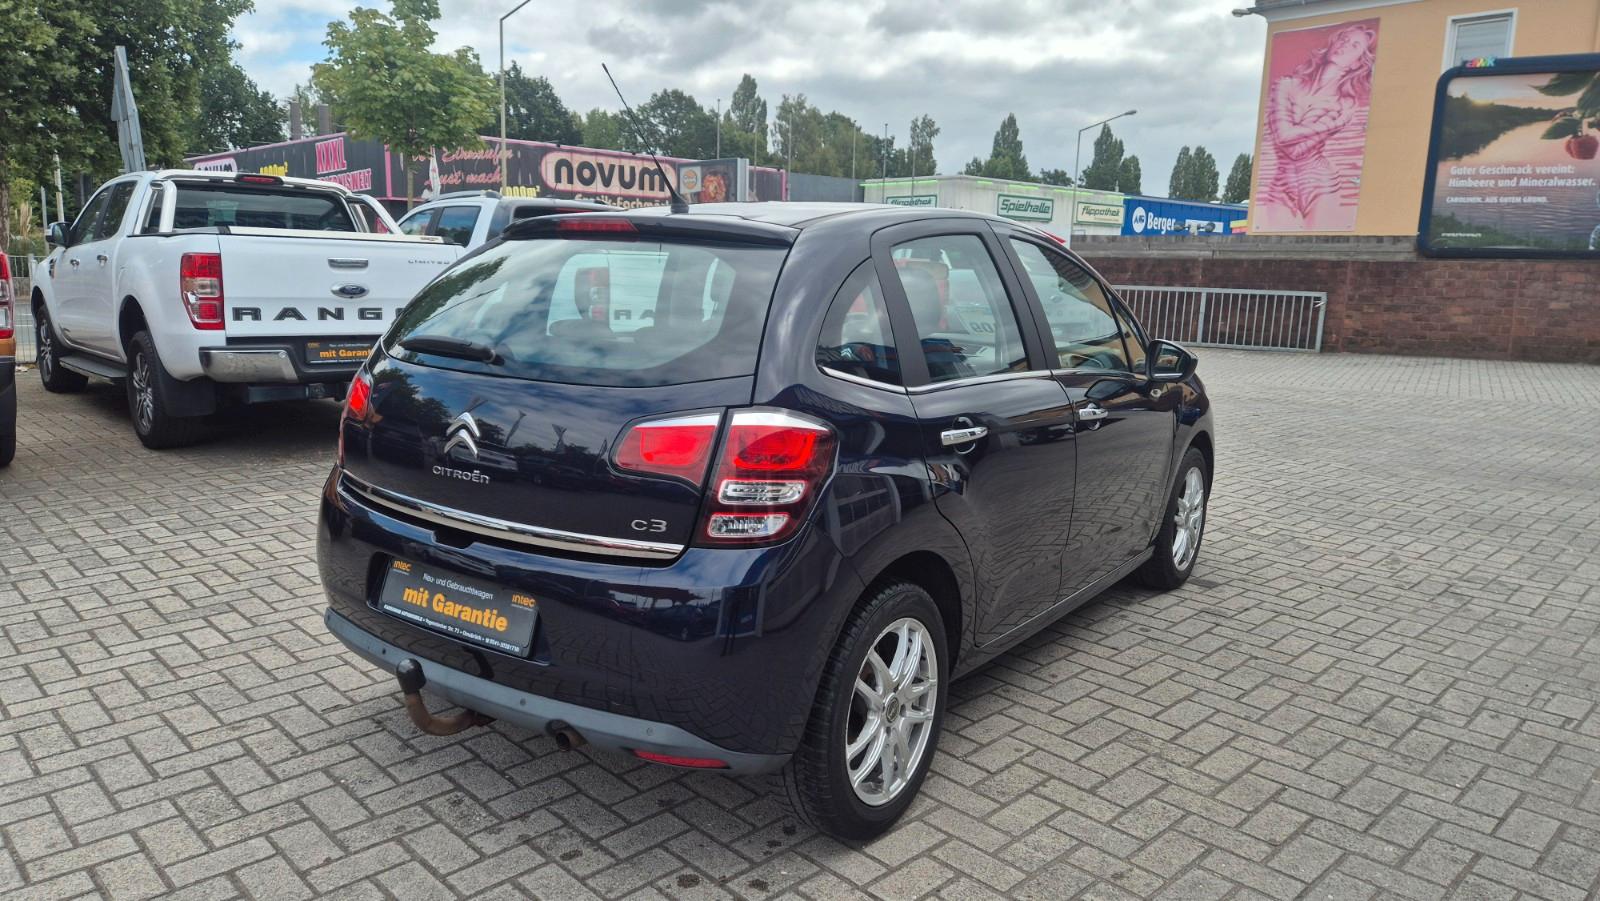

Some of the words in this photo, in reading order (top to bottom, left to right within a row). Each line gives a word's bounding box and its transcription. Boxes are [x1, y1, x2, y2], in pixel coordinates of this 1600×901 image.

[315, 137, 347, 175] XXXL
[554, 158, 665, 192] novum
[1450, 166, 1476, 175] Guter
[1479, 165, 1532, 175] Geschmack
[1536, 164, 1576, 174] vereint:
[1448, 178, 1495, 187] Himbeere
[1498, 177, 1517, 187] und
[1519, 176, 1597, 187] Mineralwasser.
[1000, 199, 1051, 213] Spielhalle
[1147, 212, 1177, 235] Berger
[320, 348, 337, 358] mit
[432, 465, 489, 484] CITROËN
[630, 518, 668, 533] C3
[393, 560, 412, 572] intec
[435, 578, 446, 586] und
[446, 579, 494, 600] Gebrauchtwagen
[511, 593, 537, 608] intec
[402, 586, 429, 608] mit
[432, 592, 509, 632] Garantie
